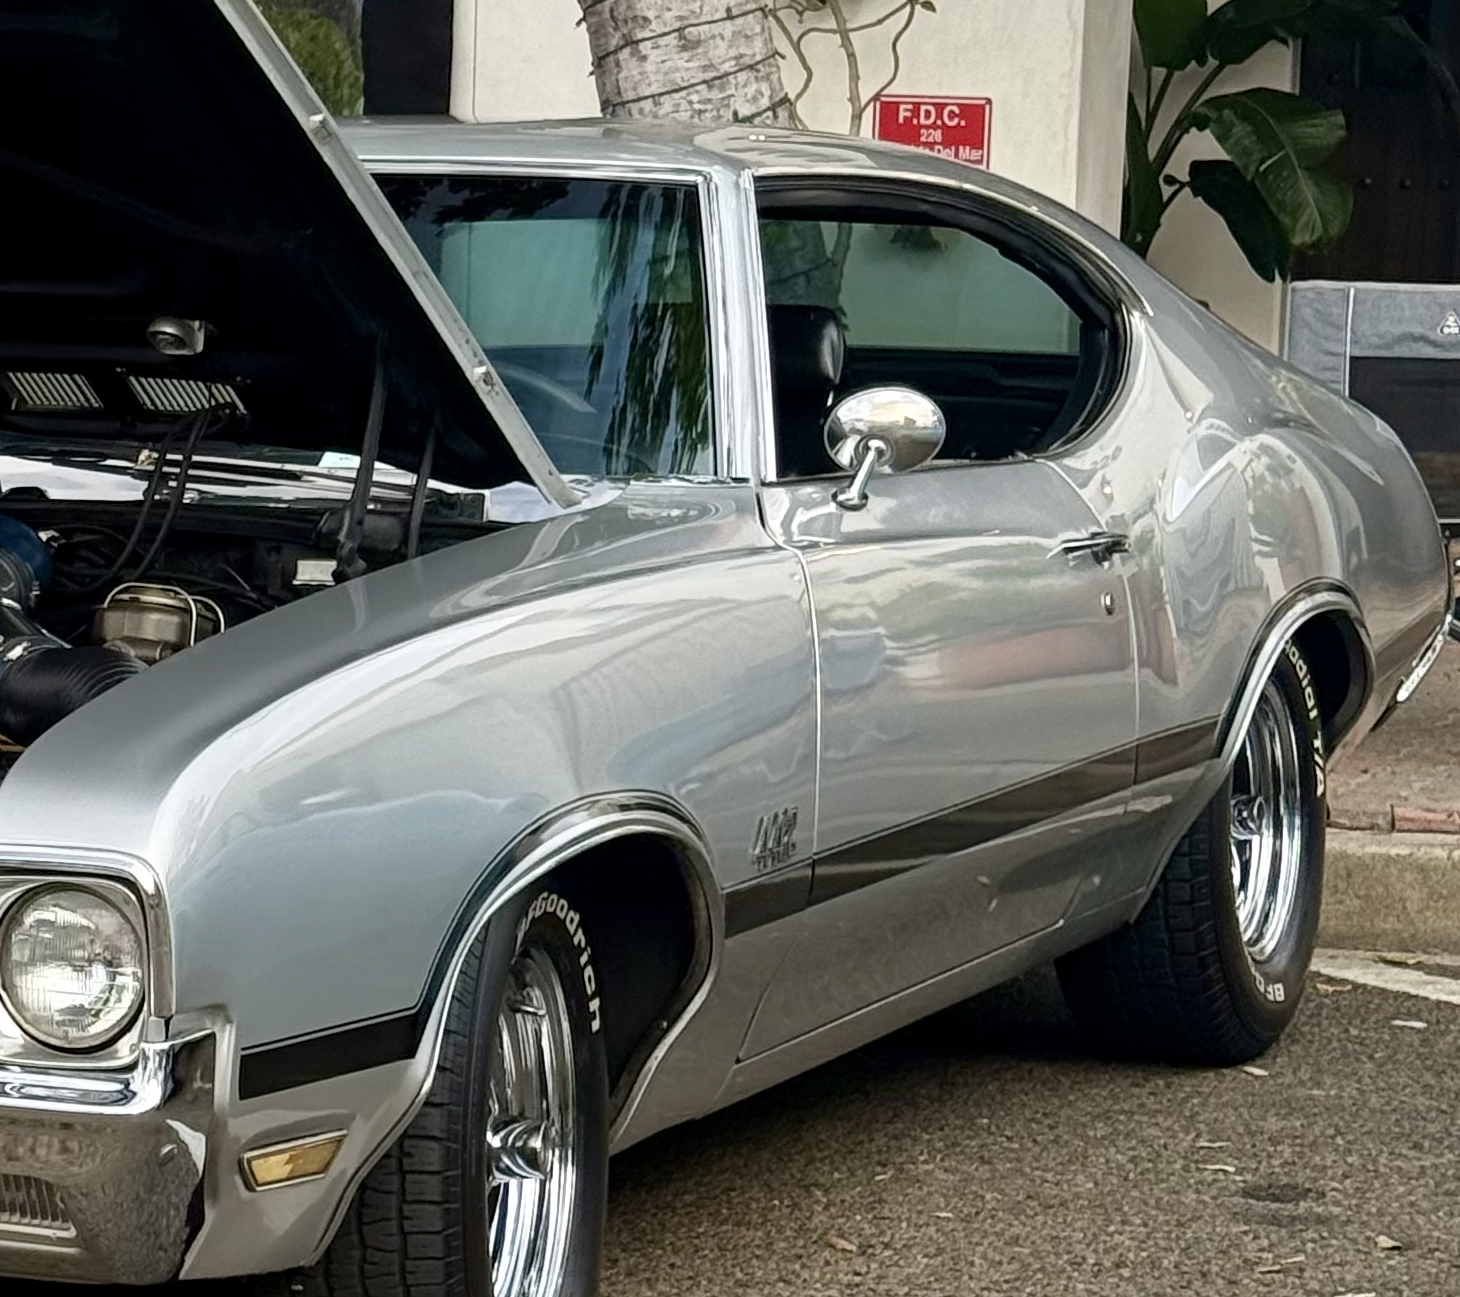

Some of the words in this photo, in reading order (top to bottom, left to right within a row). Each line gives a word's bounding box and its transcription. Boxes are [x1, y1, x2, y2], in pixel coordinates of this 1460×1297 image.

[898, 104, 966, 127] F.D.C.
[920, 129, 942, 143] 226
[934, 146, 955, 159] Del
